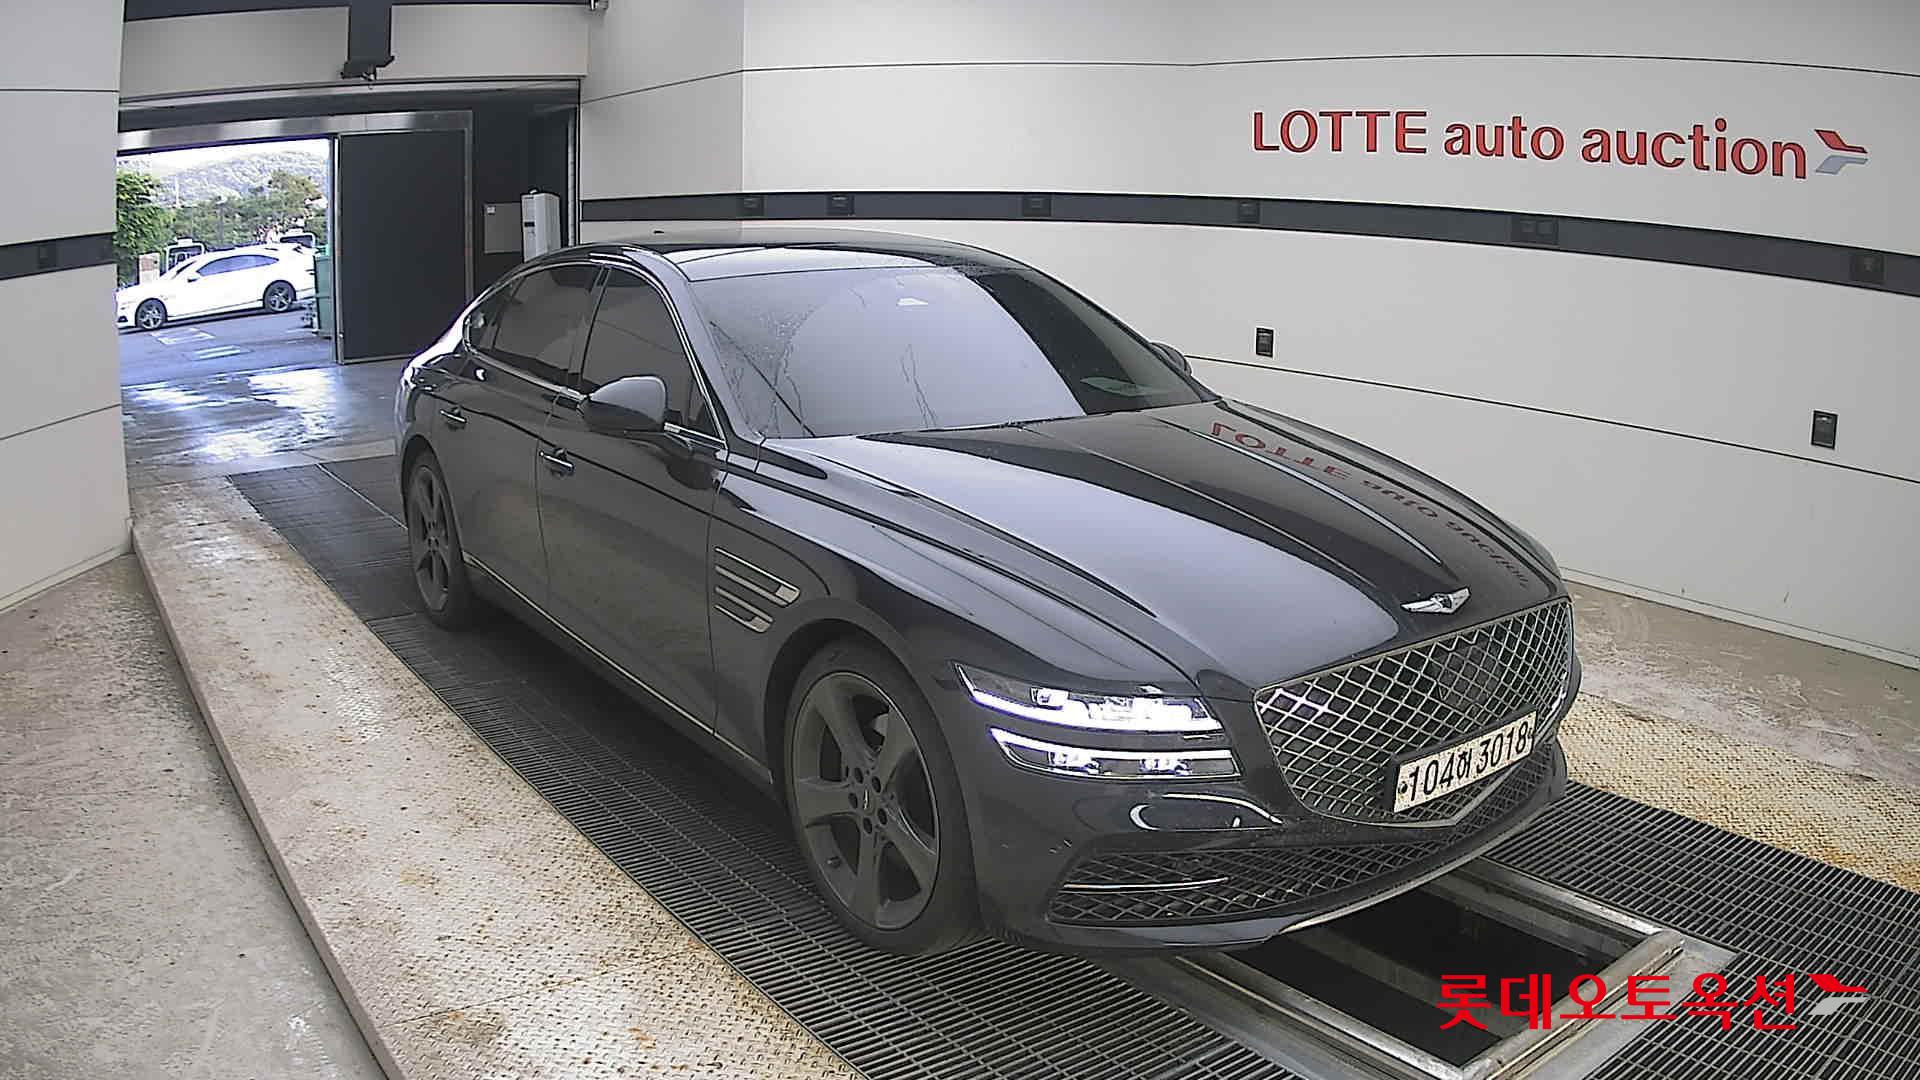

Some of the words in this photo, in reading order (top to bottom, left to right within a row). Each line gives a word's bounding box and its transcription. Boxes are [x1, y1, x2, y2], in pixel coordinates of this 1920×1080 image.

[1253, 110, 1426, 153] LOTTE
[1444, 115, 1565, 160] auto
[1581, 117, 1807, 179] auction
[1475, 720, 1530, 774] 3018
